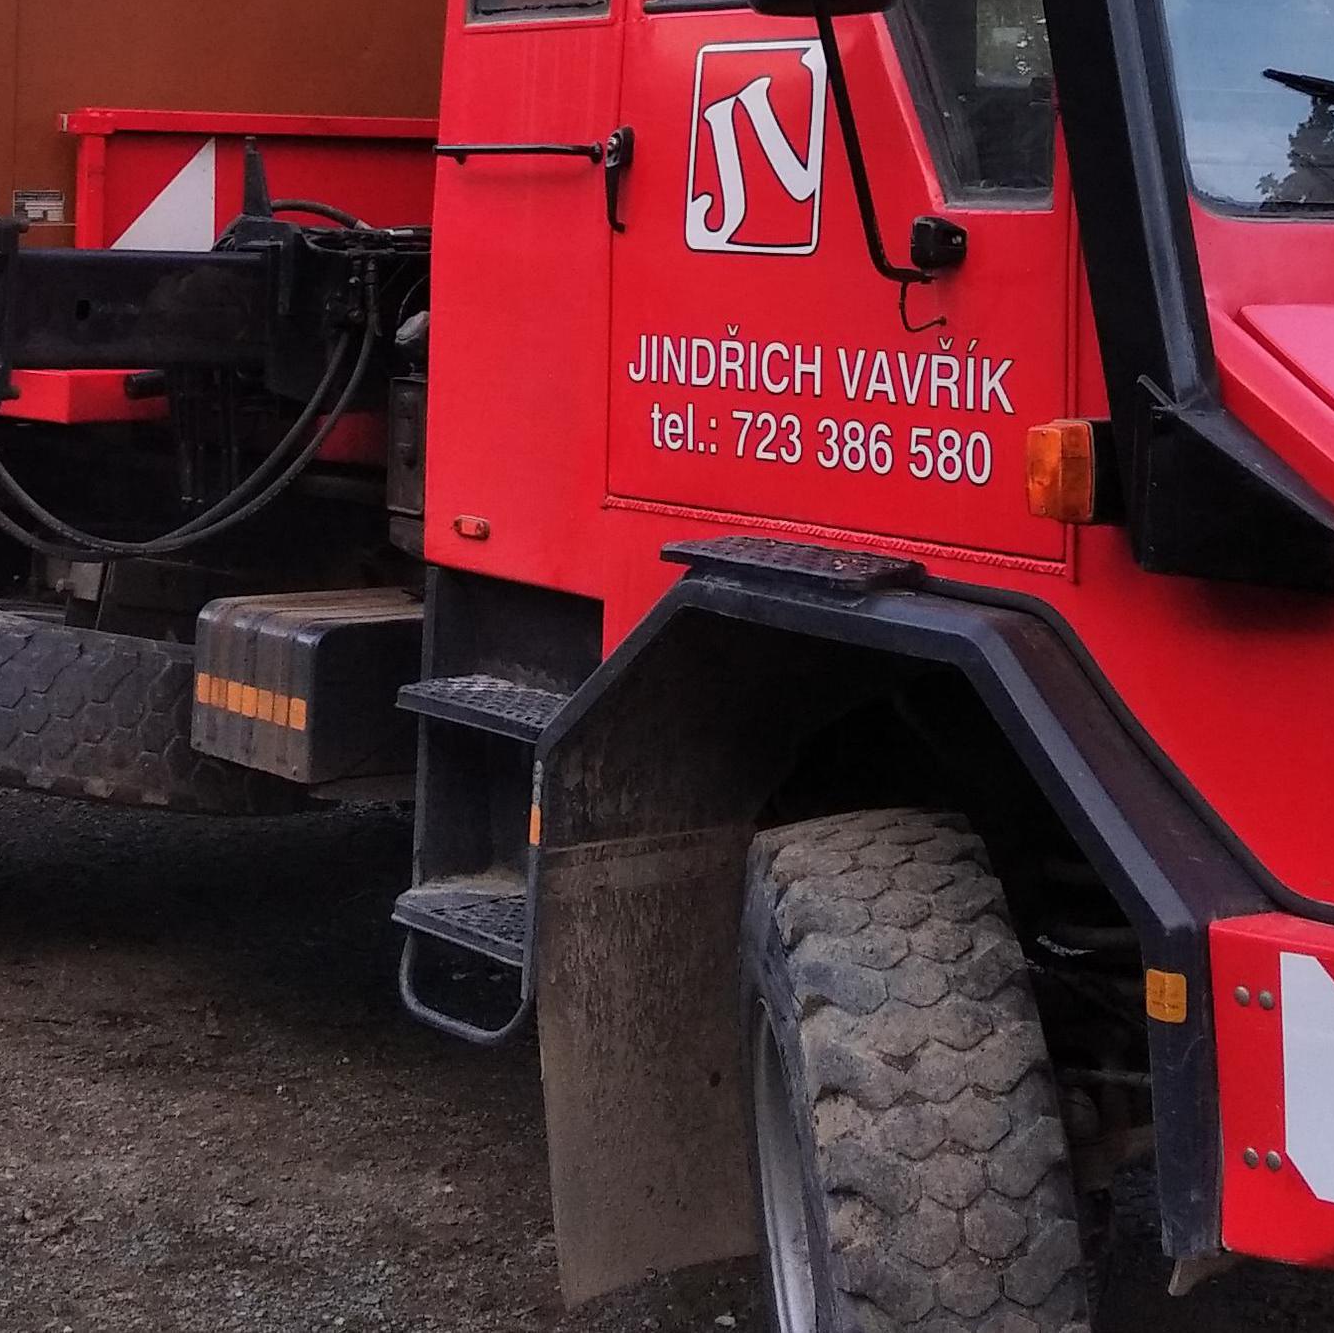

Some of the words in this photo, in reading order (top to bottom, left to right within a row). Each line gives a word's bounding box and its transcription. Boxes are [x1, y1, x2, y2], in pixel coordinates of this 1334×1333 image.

[627, 323, 823, 397] JINDŘICH
[835, 336, 1016, 415] VAVŘÍK
[650, 402, 718, 454] tel.:
[731, 410, 804, 463] 723
[816, 418, 893, 474] 386
[907, 426, 993, 485] 580
